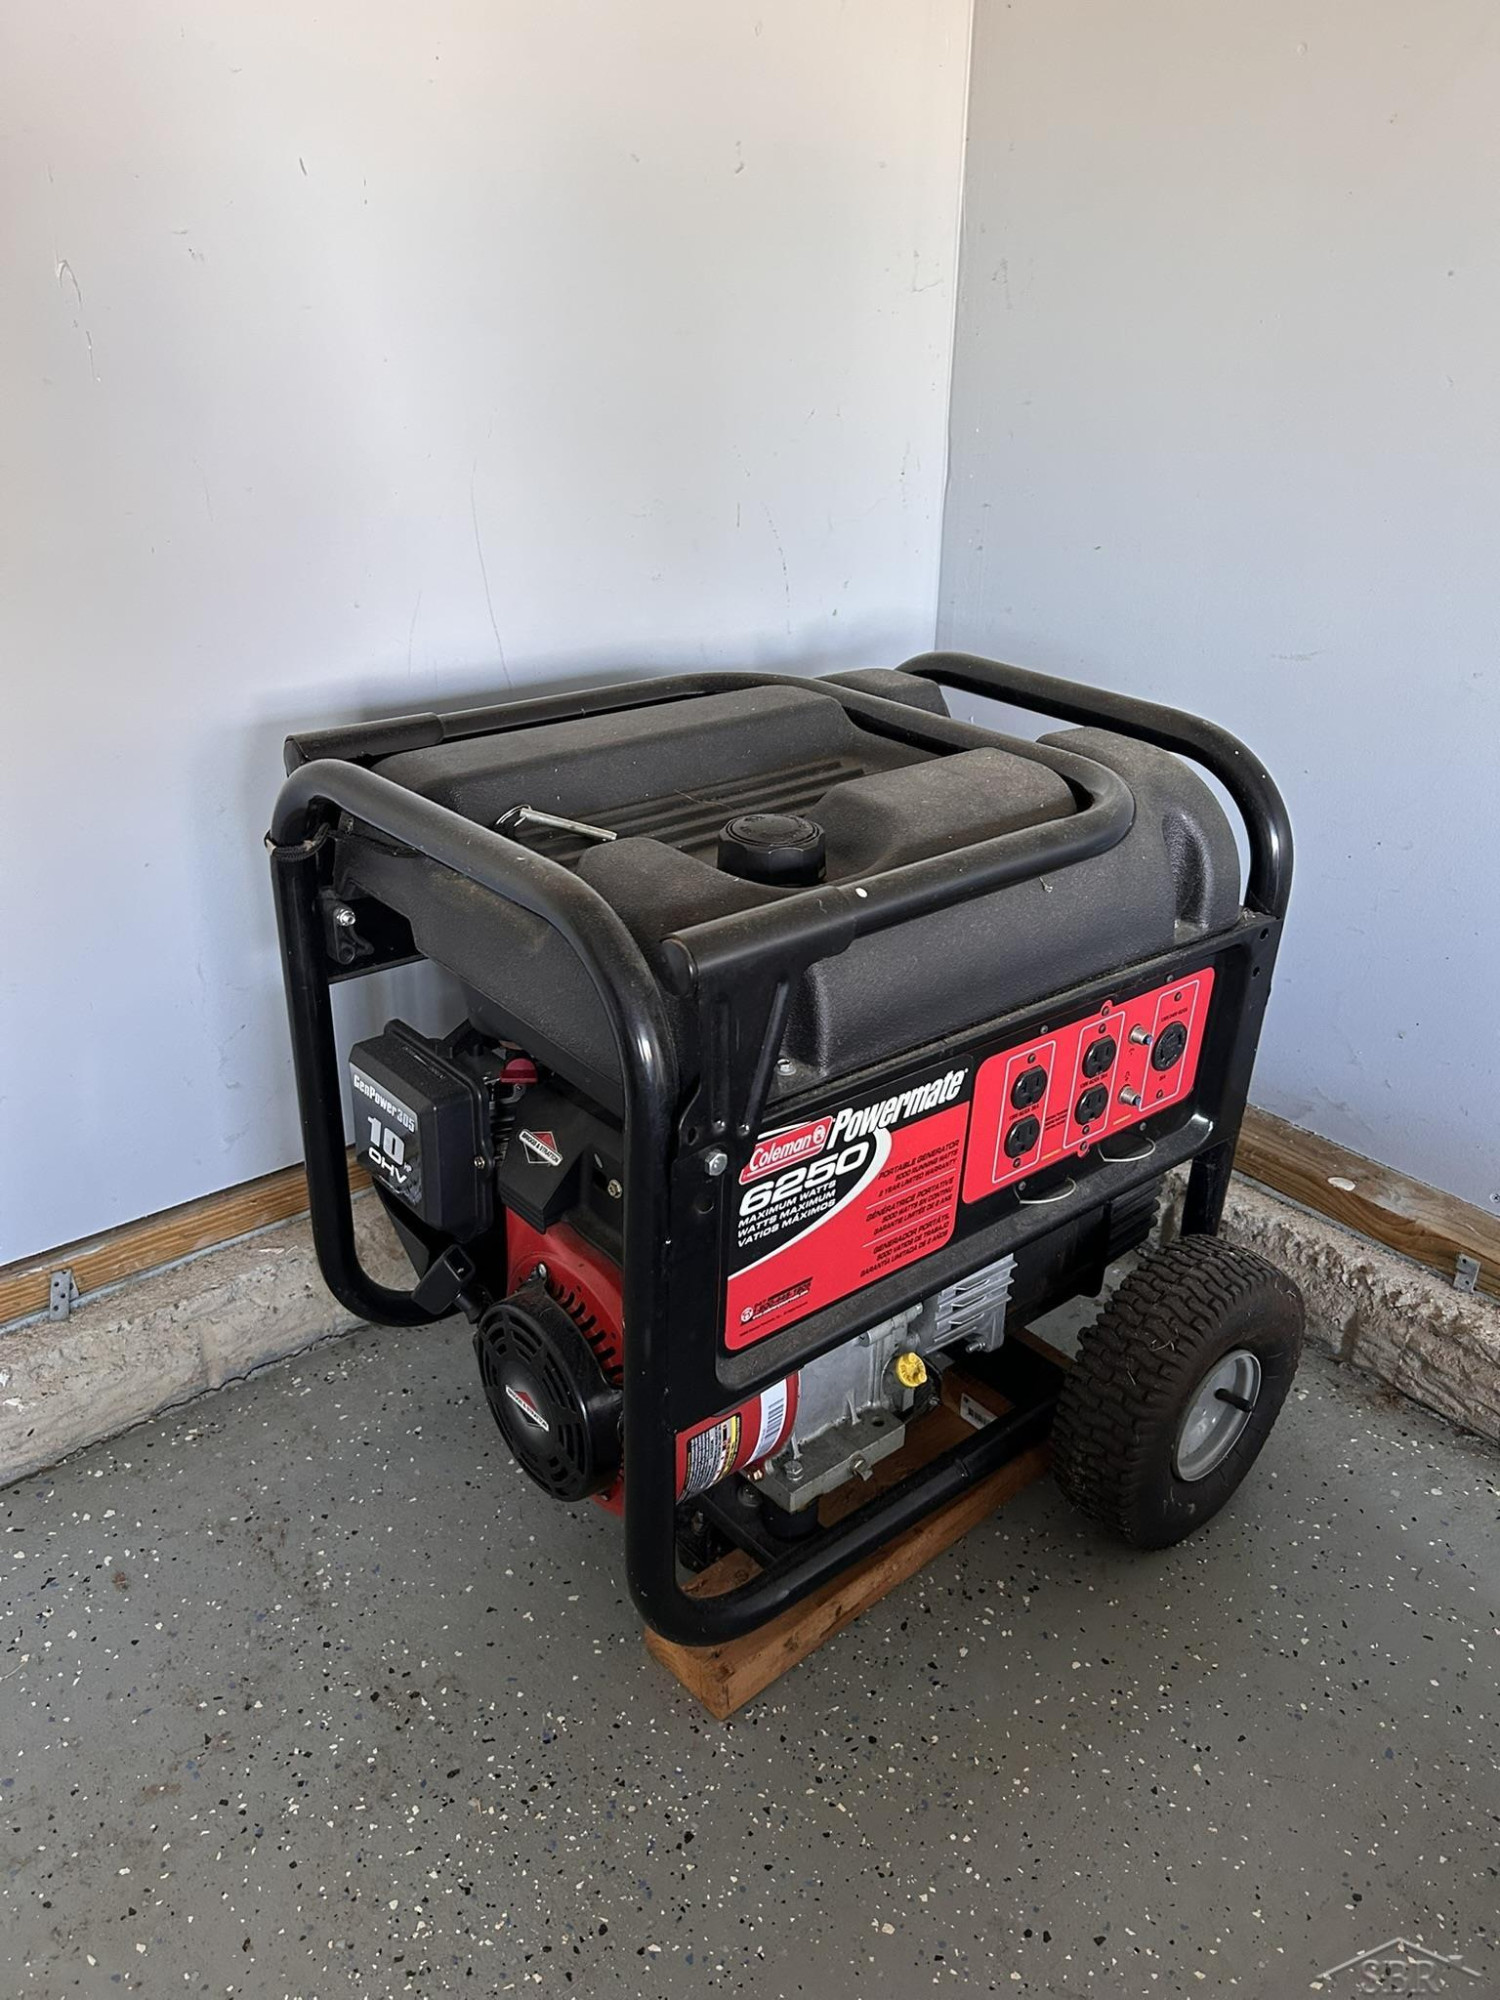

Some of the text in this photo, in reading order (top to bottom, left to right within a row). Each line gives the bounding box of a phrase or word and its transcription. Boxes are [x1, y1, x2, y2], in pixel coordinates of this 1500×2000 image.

[354, 1074, 396, 1116] GenPower
[826, 1069, 966, 1150] Powermate
[368, 1116, 405, 1166] 10
[750, 1134, 812, 1172] Coleman
[878, 1139, 959, 1180] PORTABLE GENERATOR
[911, 1158, 938, 1173] RUNNING
[939, 1149, 958, 1161] WATTS
[369, 1147, 407, 1184] OHV
[739, 1142, 870, 1217] 6250
[885, 1182, 901, 1193] YEAR
[901, 1171, 924, 1186] LIMITED
[925, 1157, 957, 1176] WARRANTY
[738, 1180, 837, 1228] MAXIMUM WATTS
[916, 1176, 955, 1198] PORTATIVE
[738, 1189, 836, 1238] WATTS MAXIMUM
[738, 1198, 836, 1247] VATIOS MÁXIMOS
[873, 1228, 918, 1254] GENERADOR
